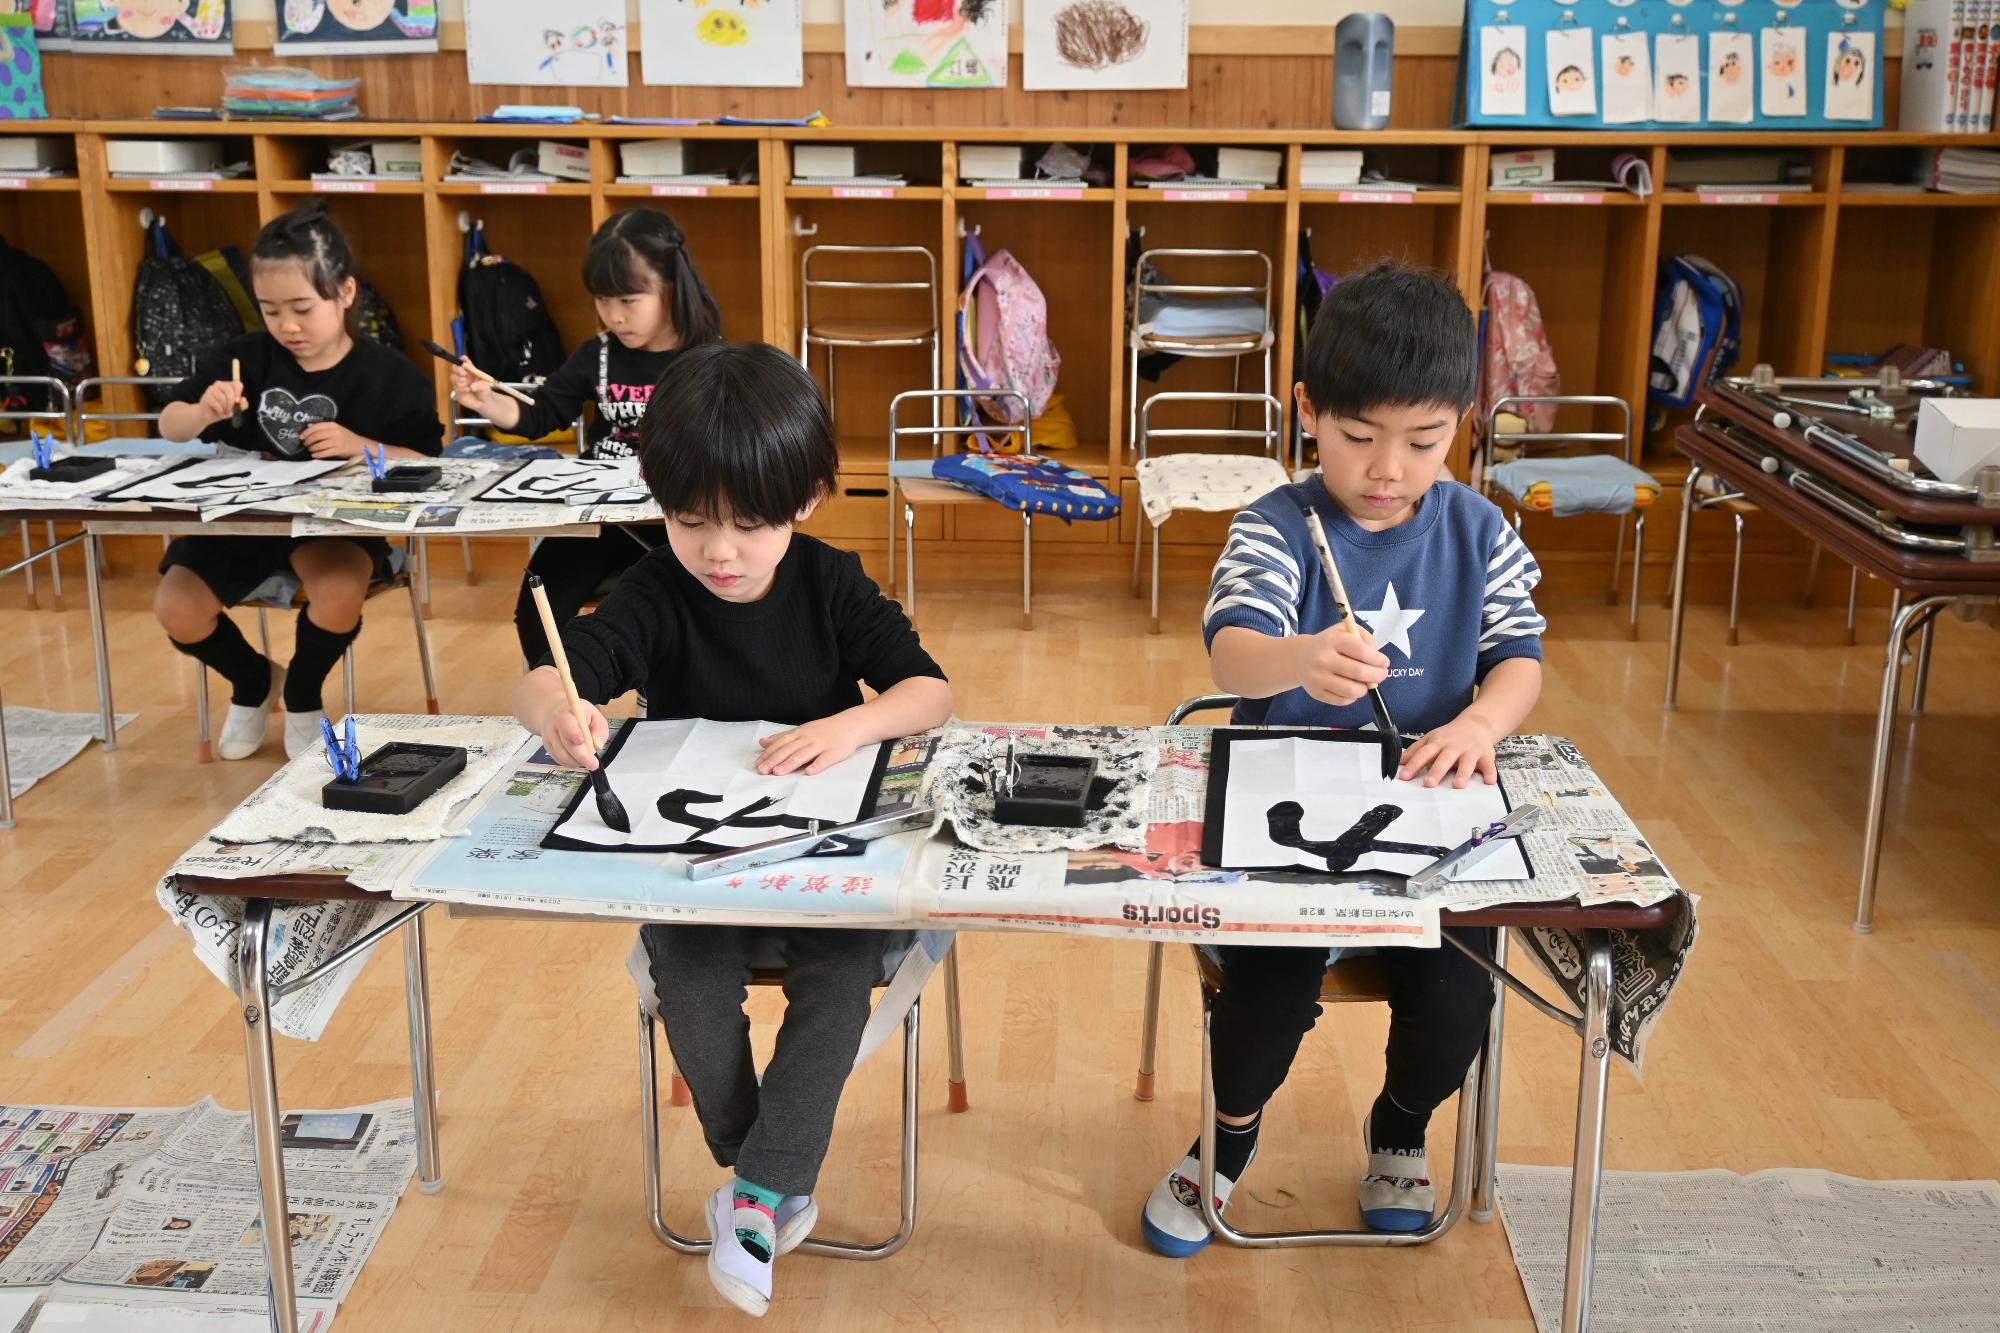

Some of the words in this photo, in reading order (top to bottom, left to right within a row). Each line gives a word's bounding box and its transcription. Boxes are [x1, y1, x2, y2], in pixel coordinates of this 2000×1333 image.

[1385, 668, 1408, 678] UCKY
[1408, 667, 1425, 677] DAY
[1121, 903, 1222, 930] Sports
[286, 1194, 378, 1211] 高速バス早朝便再
